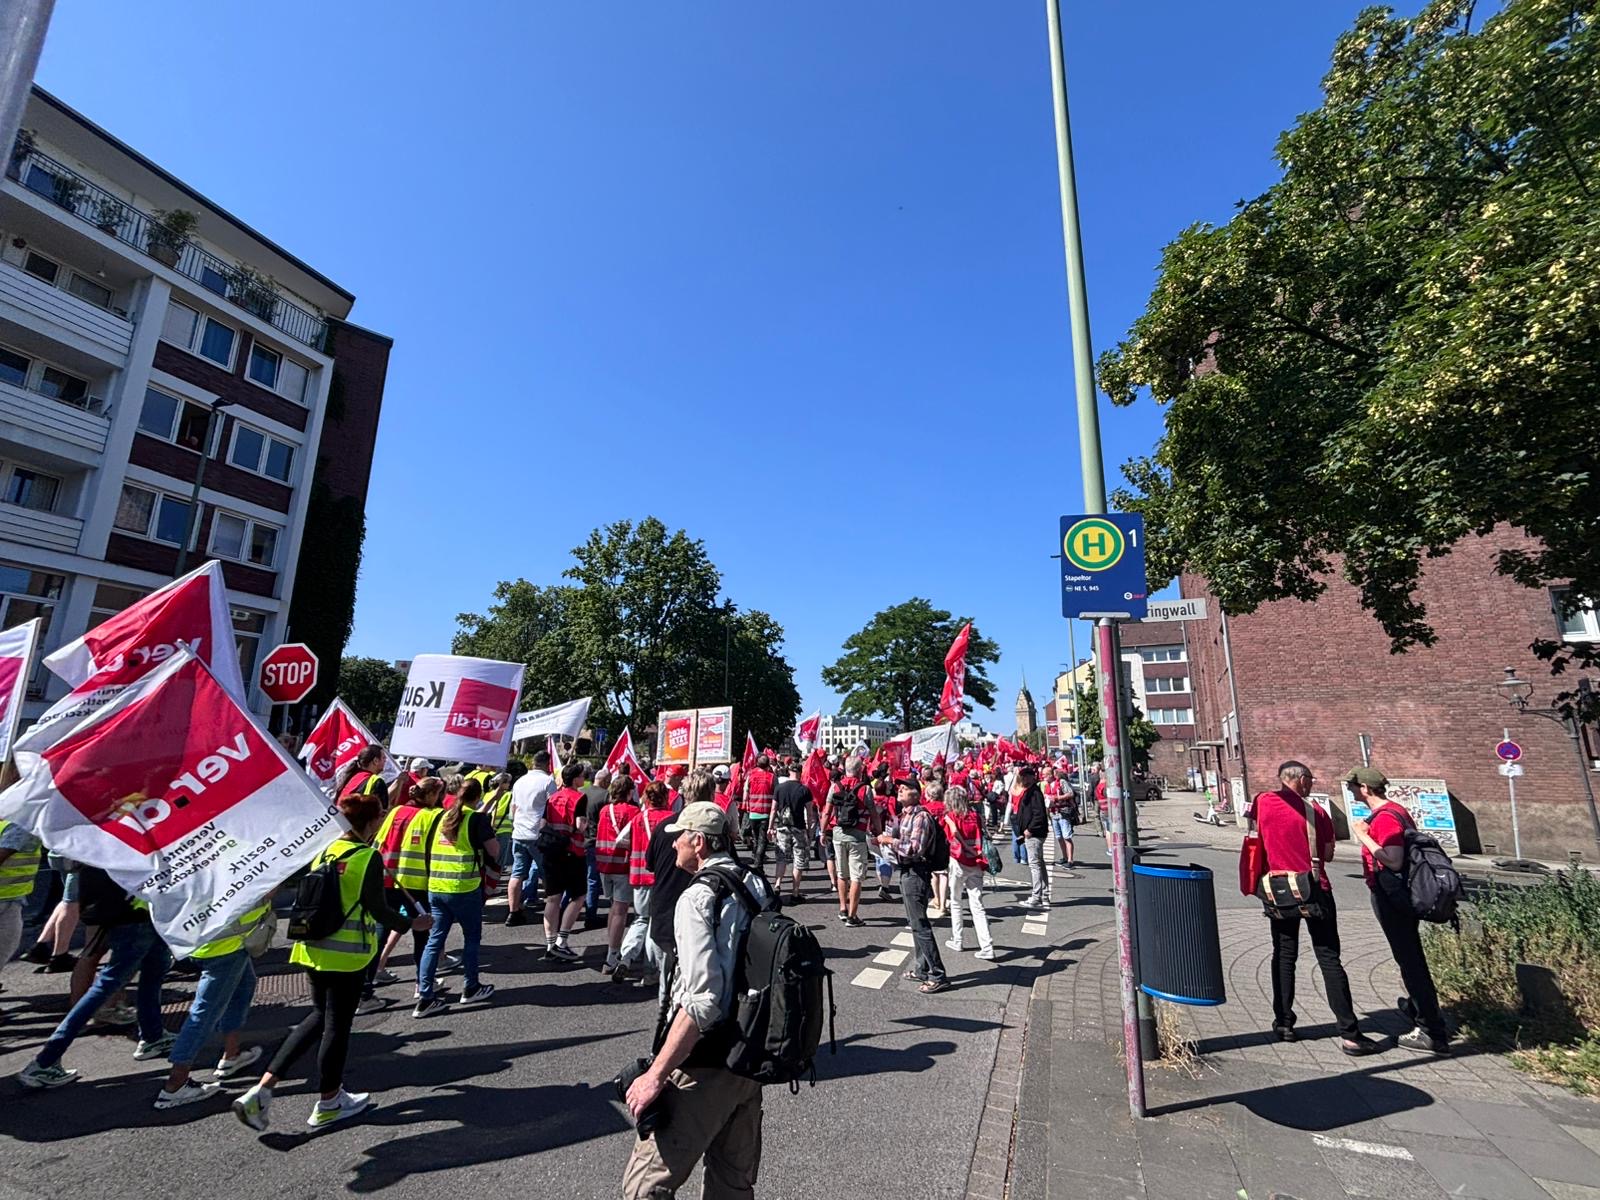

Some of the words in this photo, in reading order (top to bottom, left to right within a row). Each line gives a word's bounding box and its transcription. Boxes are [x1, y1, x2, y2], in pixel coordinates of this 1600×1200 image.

[1082, 532, 1106, 557] H
[1128, 528, 1137, 547] 1
[1147, 602, 1197, 620] ingwall
[264, 661, 311, 685] STOP
